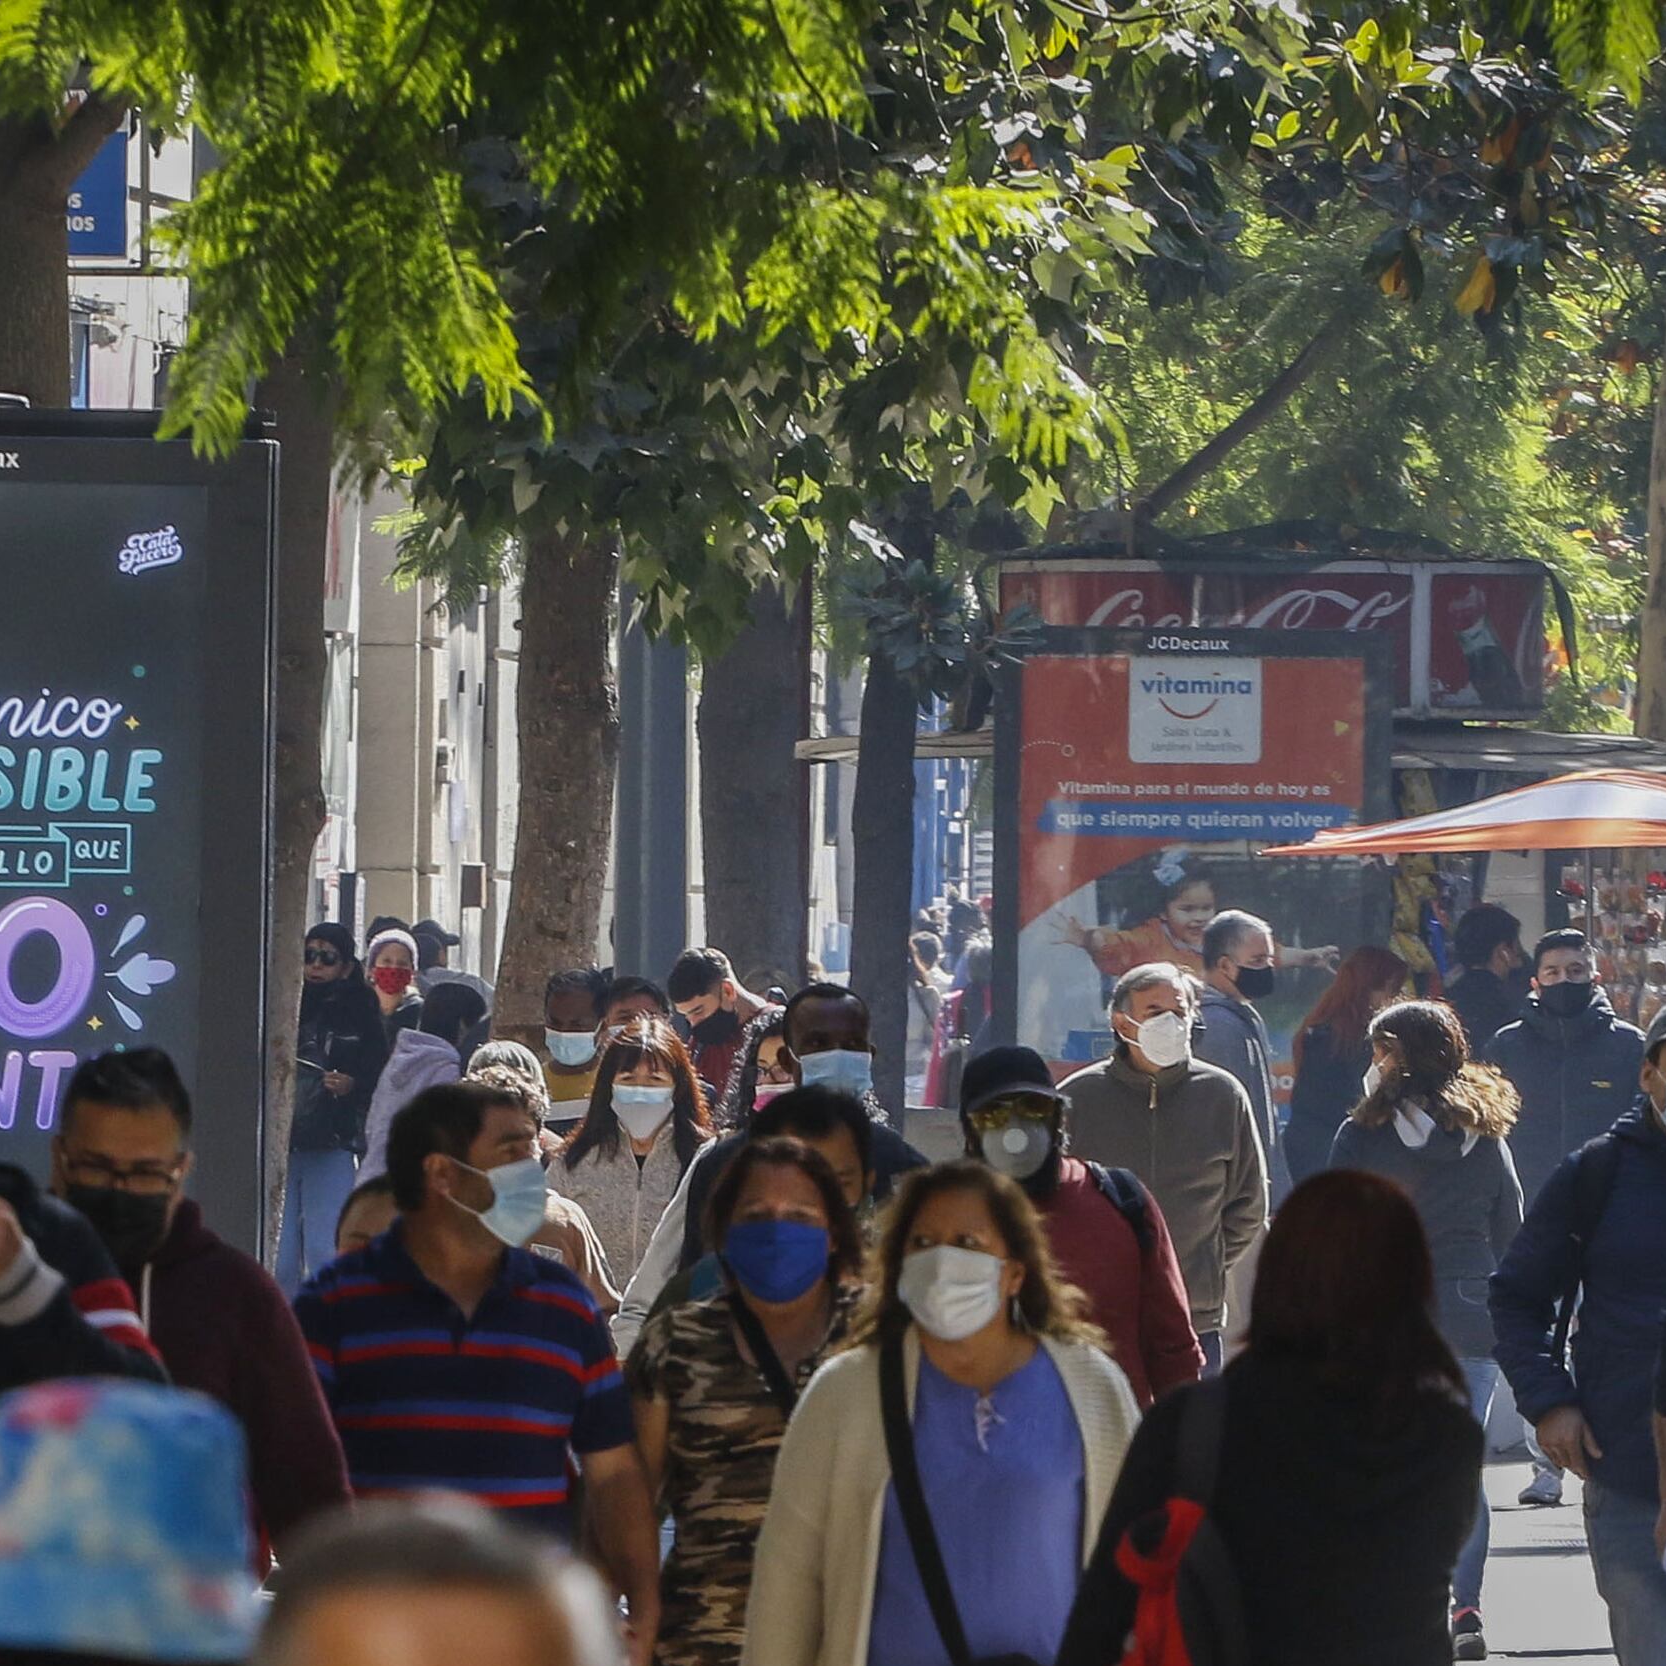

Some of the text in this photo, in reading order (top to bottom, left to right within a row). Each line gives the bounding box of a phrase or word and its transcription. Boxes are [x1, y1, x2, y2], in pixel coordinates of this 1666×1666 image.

[1147, 636, 1230, 651] JCDecaux
[1141, 671, 1253, 695] vitamina
[1058, 781, 1331, 799] Vitamina para el mundo de hoy es
[1056, 810, 1333, 830] que siempre quieran volver
[74, 840, 122, 860] QUE
